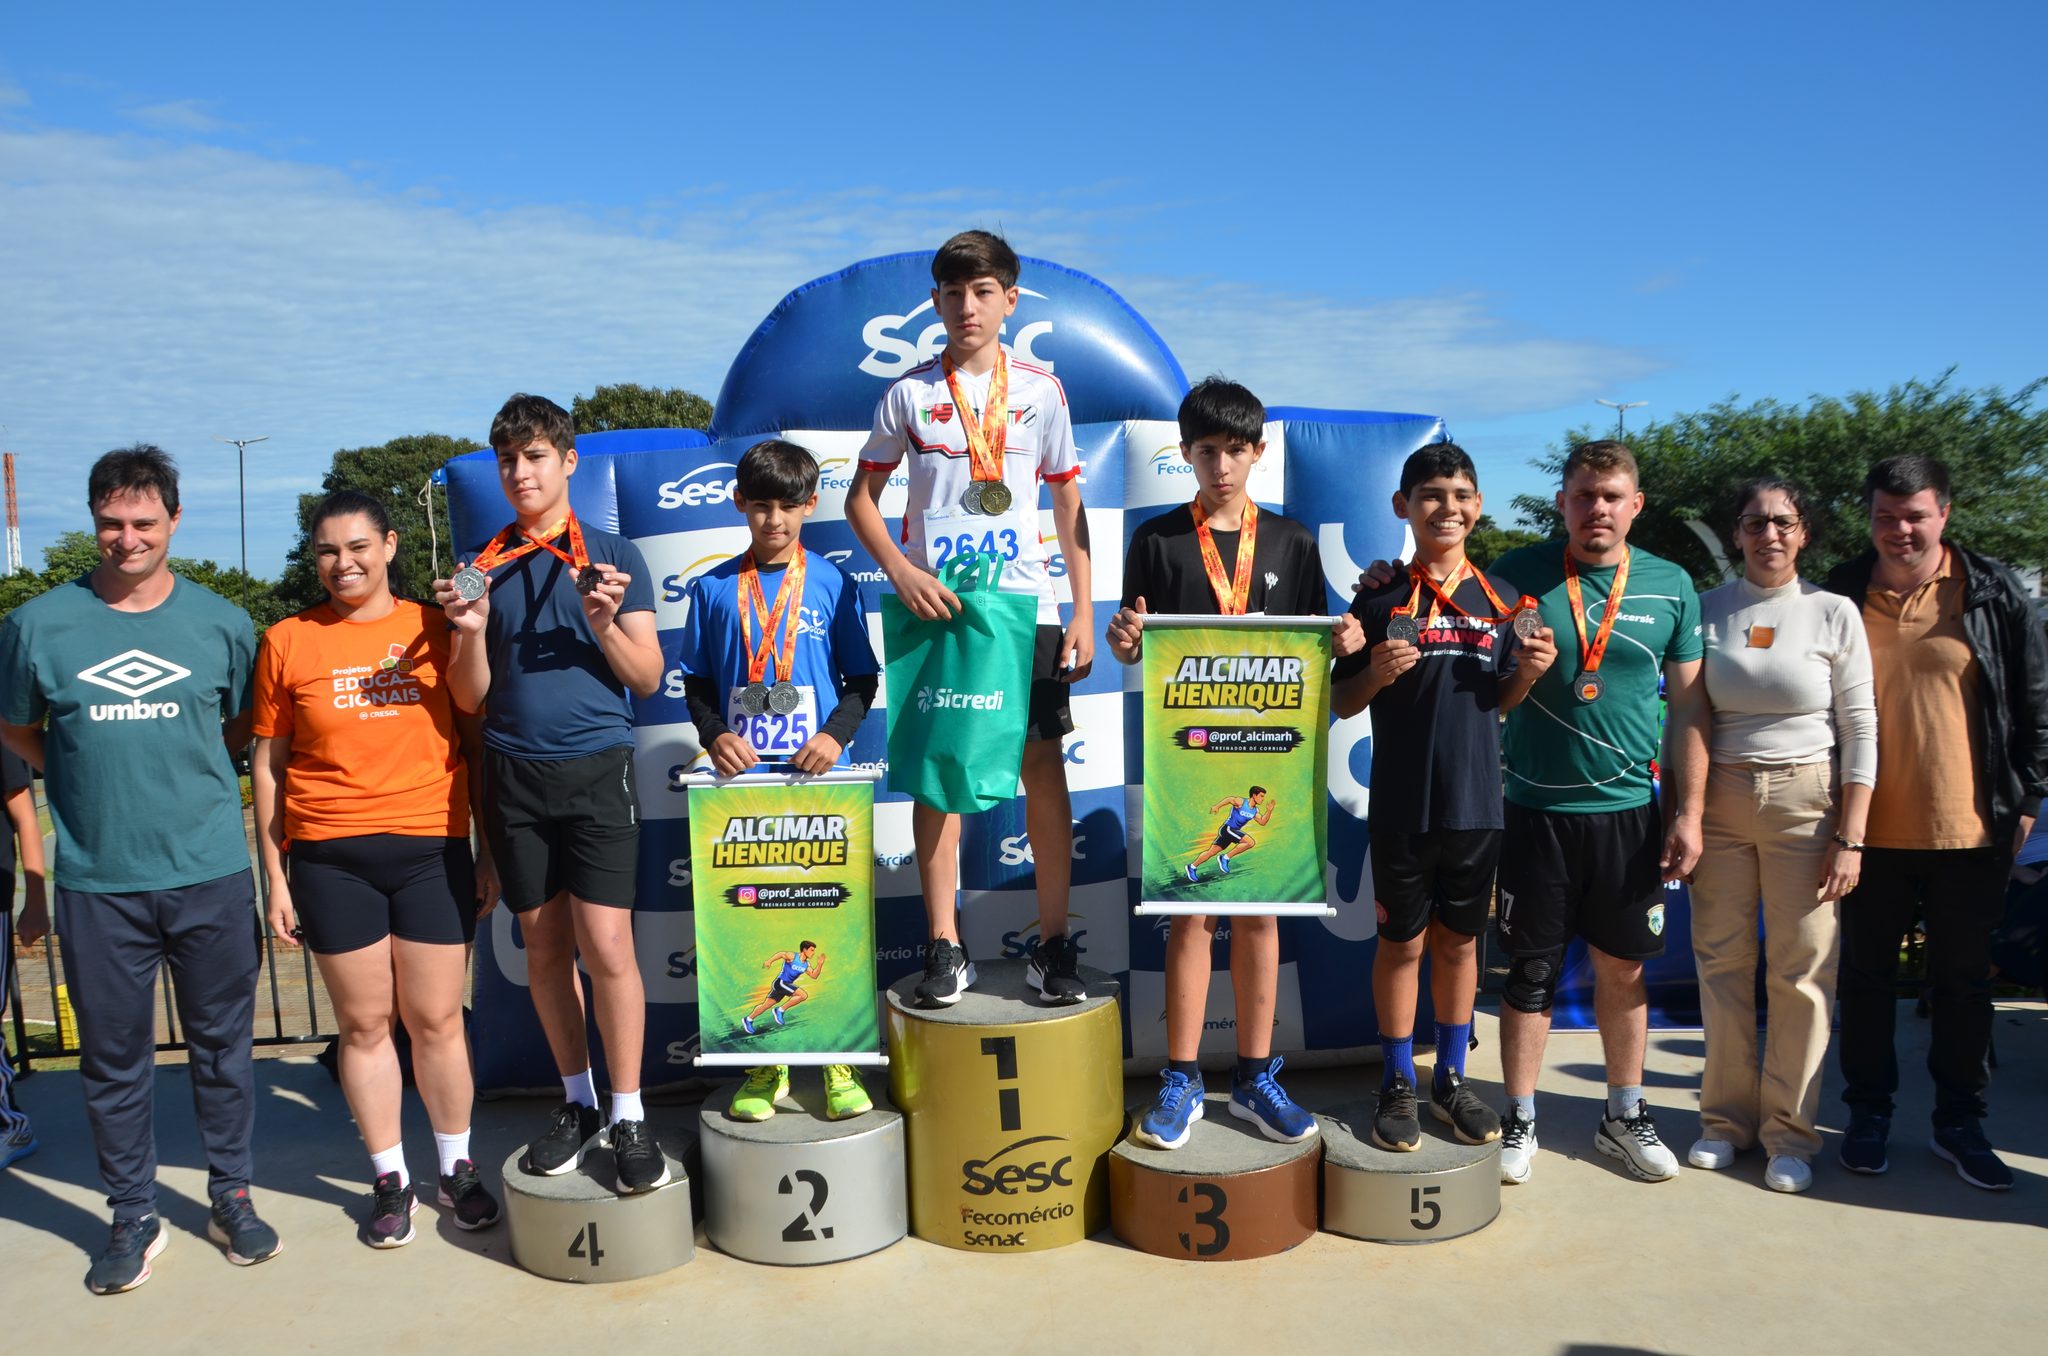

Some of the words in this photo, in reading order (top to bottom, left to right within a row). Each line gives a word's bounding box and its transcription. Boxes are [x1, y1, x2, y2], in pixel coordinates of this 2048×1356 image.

[857, 314, 1055, 378] Sec
[933, 528, 1019, 569] 2643
[1418, 629, 1494, 650] TRAINER
[332, 665, 373, 676] Projetos
[1177, 658, 1301, 682] ALCIMAR
[333, 687, 421, 709] CIONAIS
[932, 688, 1004, 711] Sicredi
[1167, 683, 1300, 710] HENRIQUE
[90, 699, 180, 721] umbro
[369, 709, 400, 719] CRESOL
[734, 713, 809, 750] 2625
[1209, 731, 1293, 743] @prof_alcimarh
[724, 816, 845, 842] ALCIMAR
[715, 841, 845, 867] HENRIQUE
[758, 887, 840, 900] @prof_alcimarh
[980, 1036, 1022, 1132] 1
[961, 1156, 1073, 1196] Sesc
[778, 1169, 834, 1242] 2
[961, 1202, 1074, 1226] Fecomércio
[1410, 1186, 1442, 1231] 5
[1177, 1183, 1231, 1256] 3
[567, 1222, 605, 1266] 4
[964, 1231, 1025, 1247] Senac
